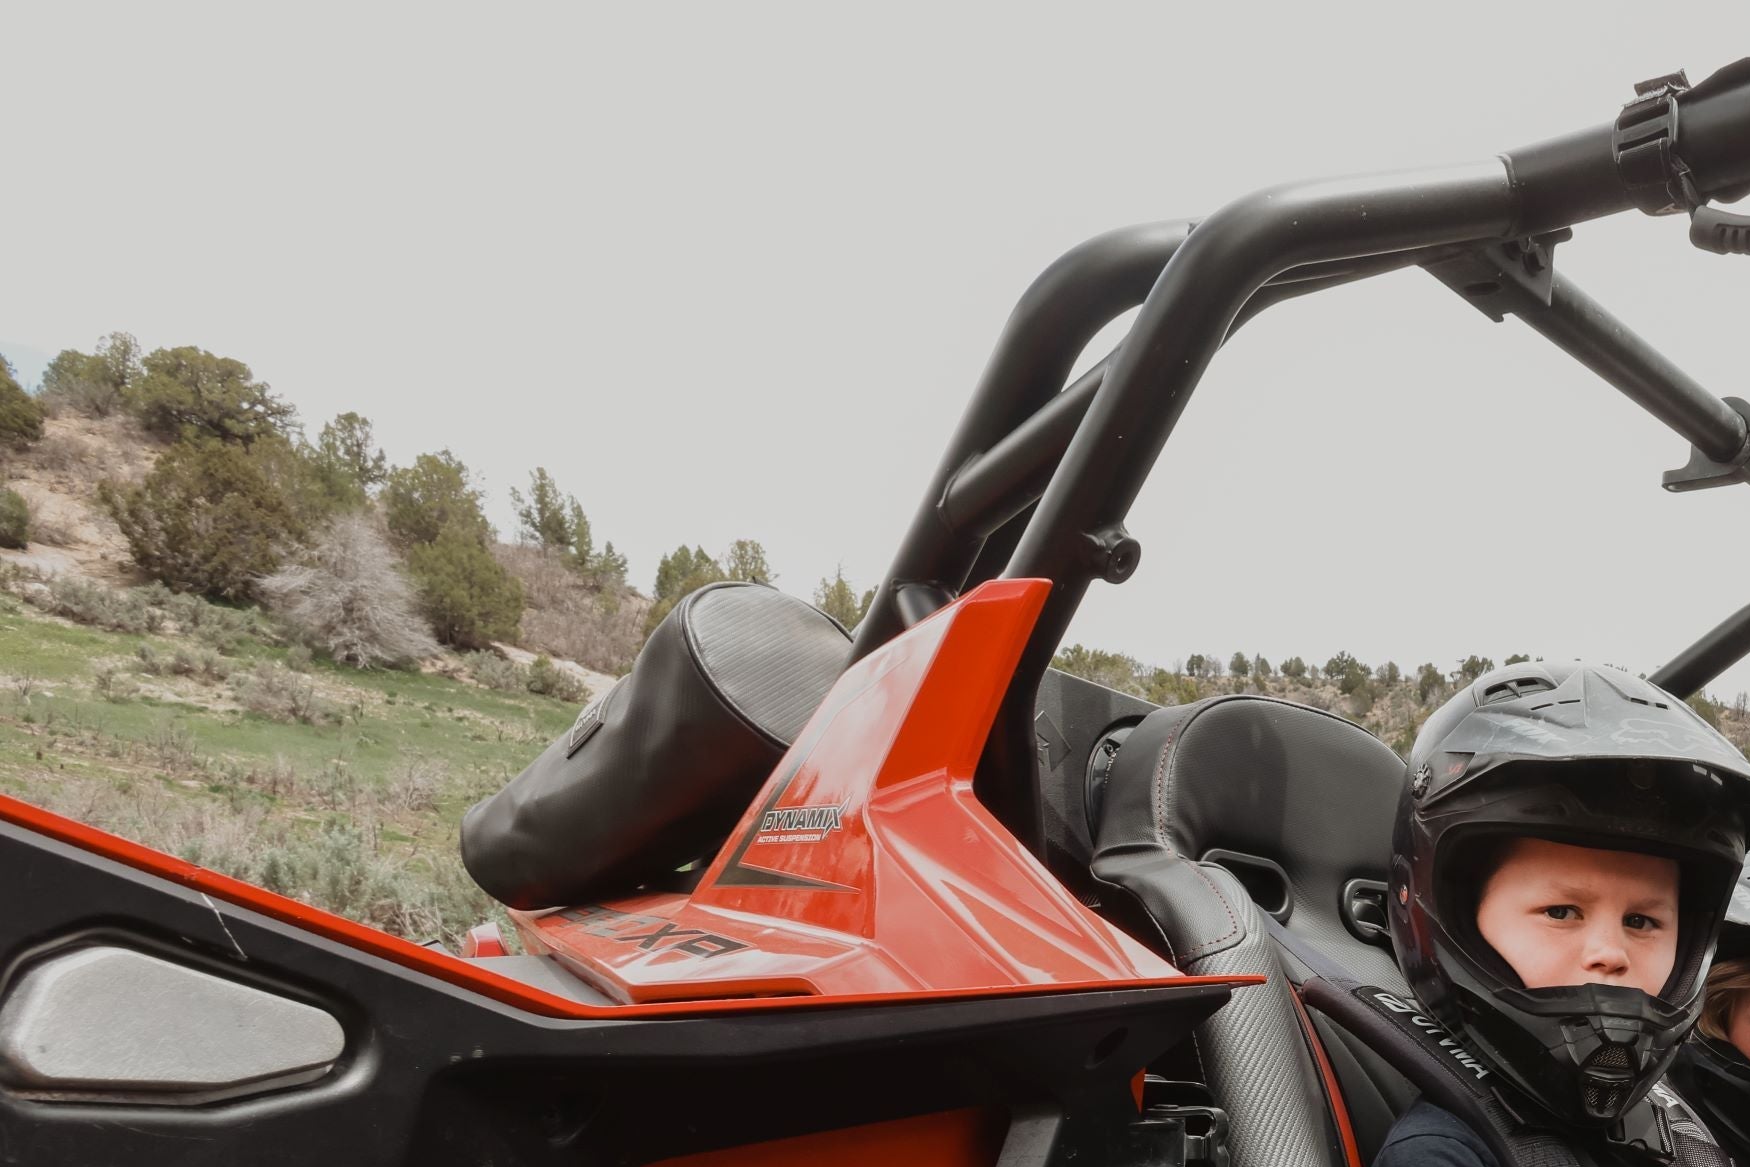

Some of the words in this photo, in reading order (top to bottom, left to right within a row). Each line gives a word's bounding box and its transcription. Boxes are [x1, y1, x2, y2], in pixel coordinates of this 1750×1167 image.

[760, 799, 849, 839] DYNAMIX
[757, 835, 779, 843] ACTIVE
[779, 833, 821, 842] SUSPENSION
